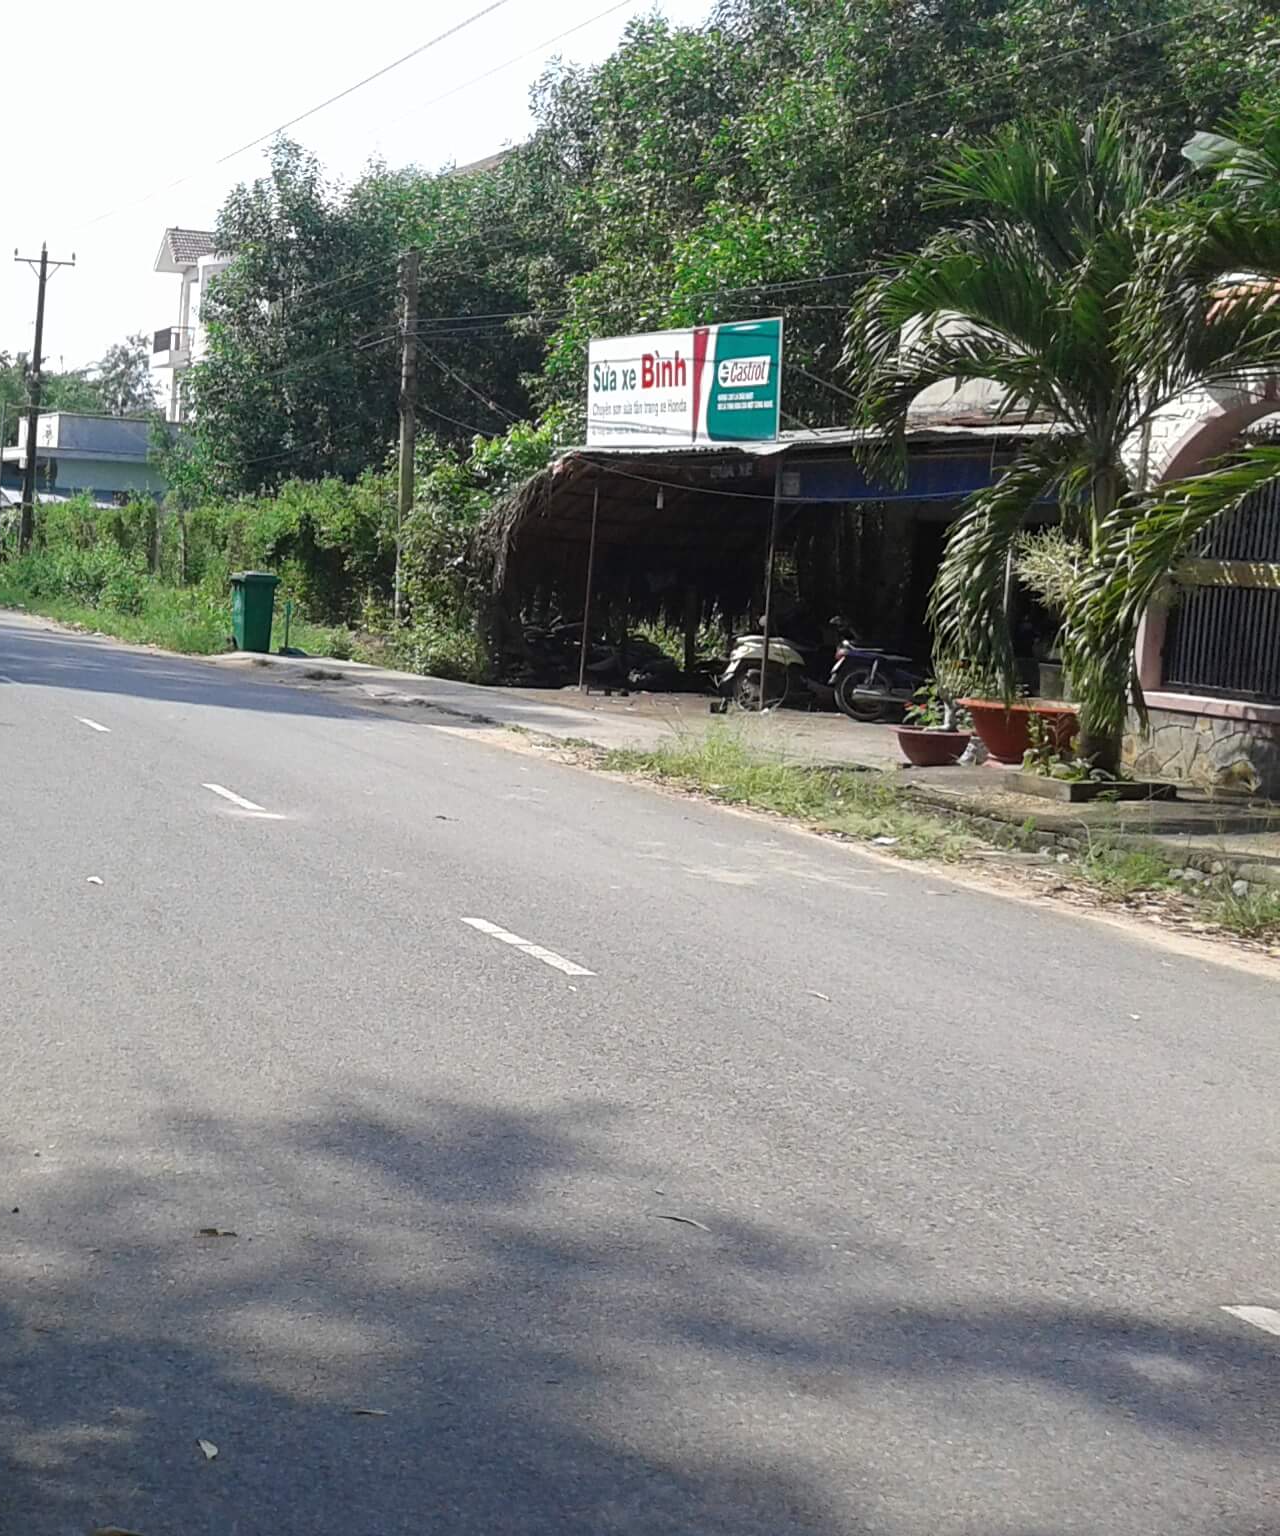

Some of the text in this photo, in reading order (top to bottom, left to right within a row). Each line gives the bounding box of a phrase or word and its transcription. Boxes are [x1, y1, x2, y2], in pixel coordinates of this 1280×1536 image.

[593, 350, 687, 392] Sửa xe Bình
[730, 360, 766, 384] Castrol
[667, 397, 687, 413] Honda
